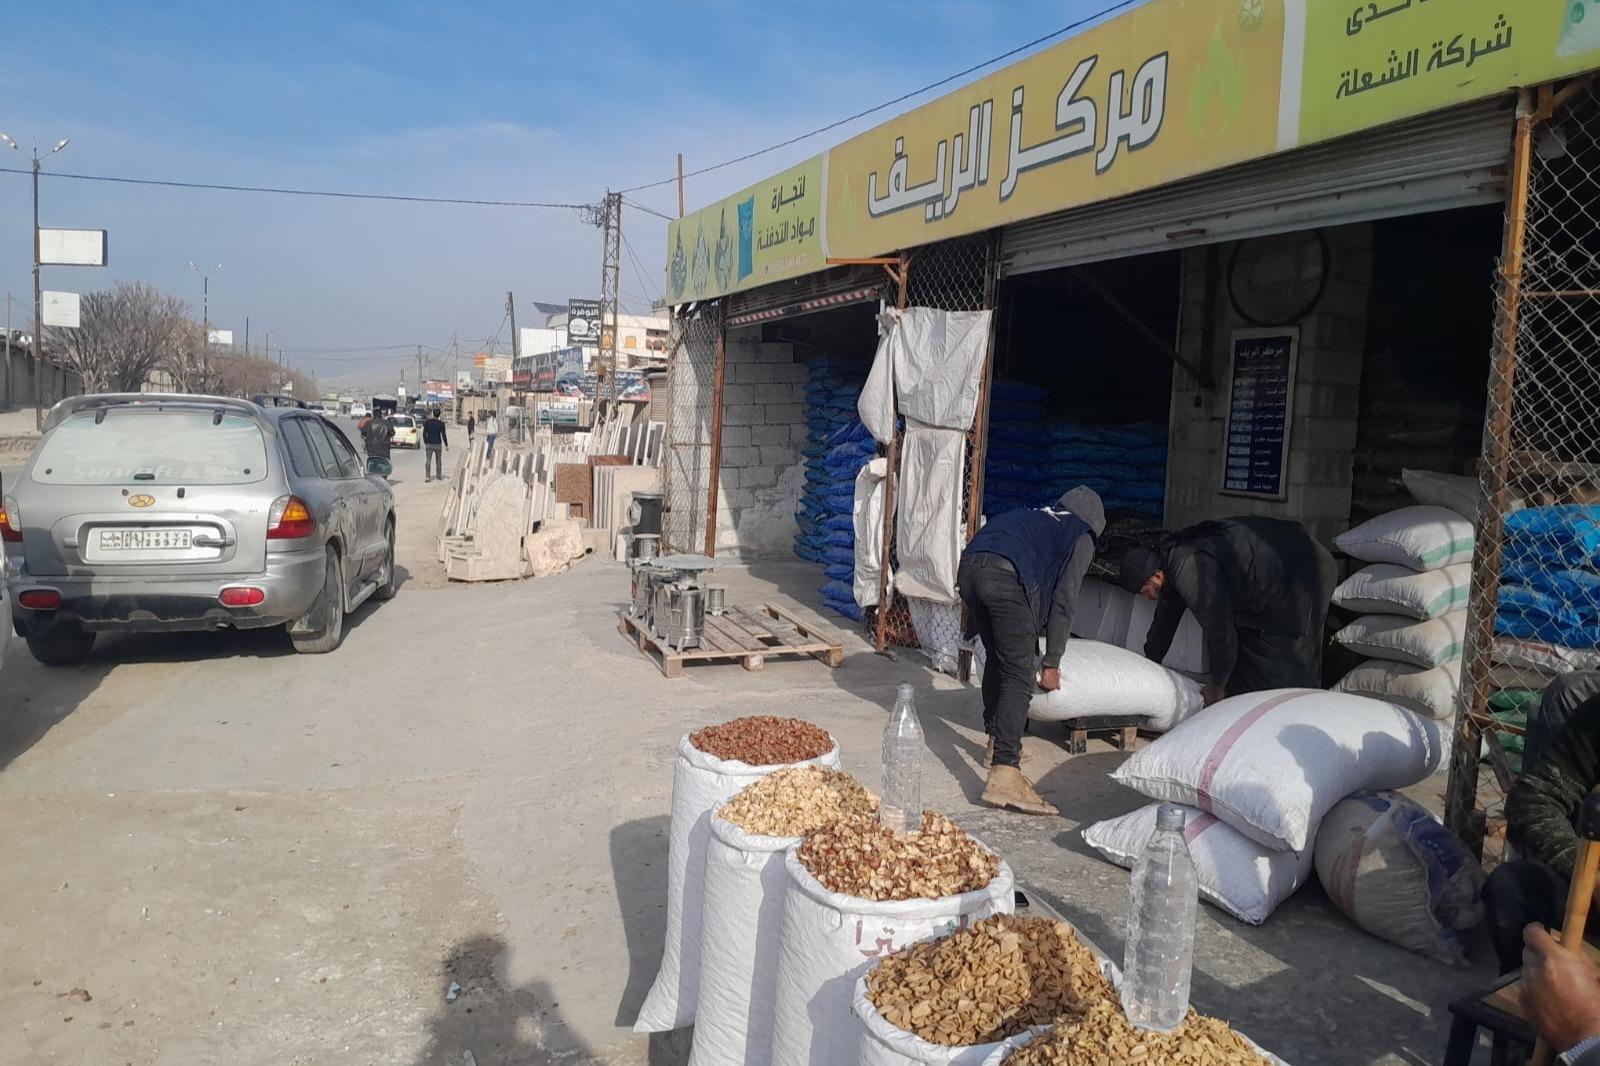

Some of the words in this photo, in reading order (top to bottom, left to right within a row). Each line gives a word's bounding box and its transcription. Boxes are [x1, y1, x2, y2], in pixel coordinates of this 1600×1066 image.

[1426, 14, 1512, 72] شركة
[1335, 49, 1419, 99] الشعلة
[1000, 51, 1168, 202] مركز
[868, 98, 993, 222] الريف
[771, 174, 806, 213] لتجارة
[757, 220, 789, 251] التدفئة
[790, 216, 815, 244] مواد
